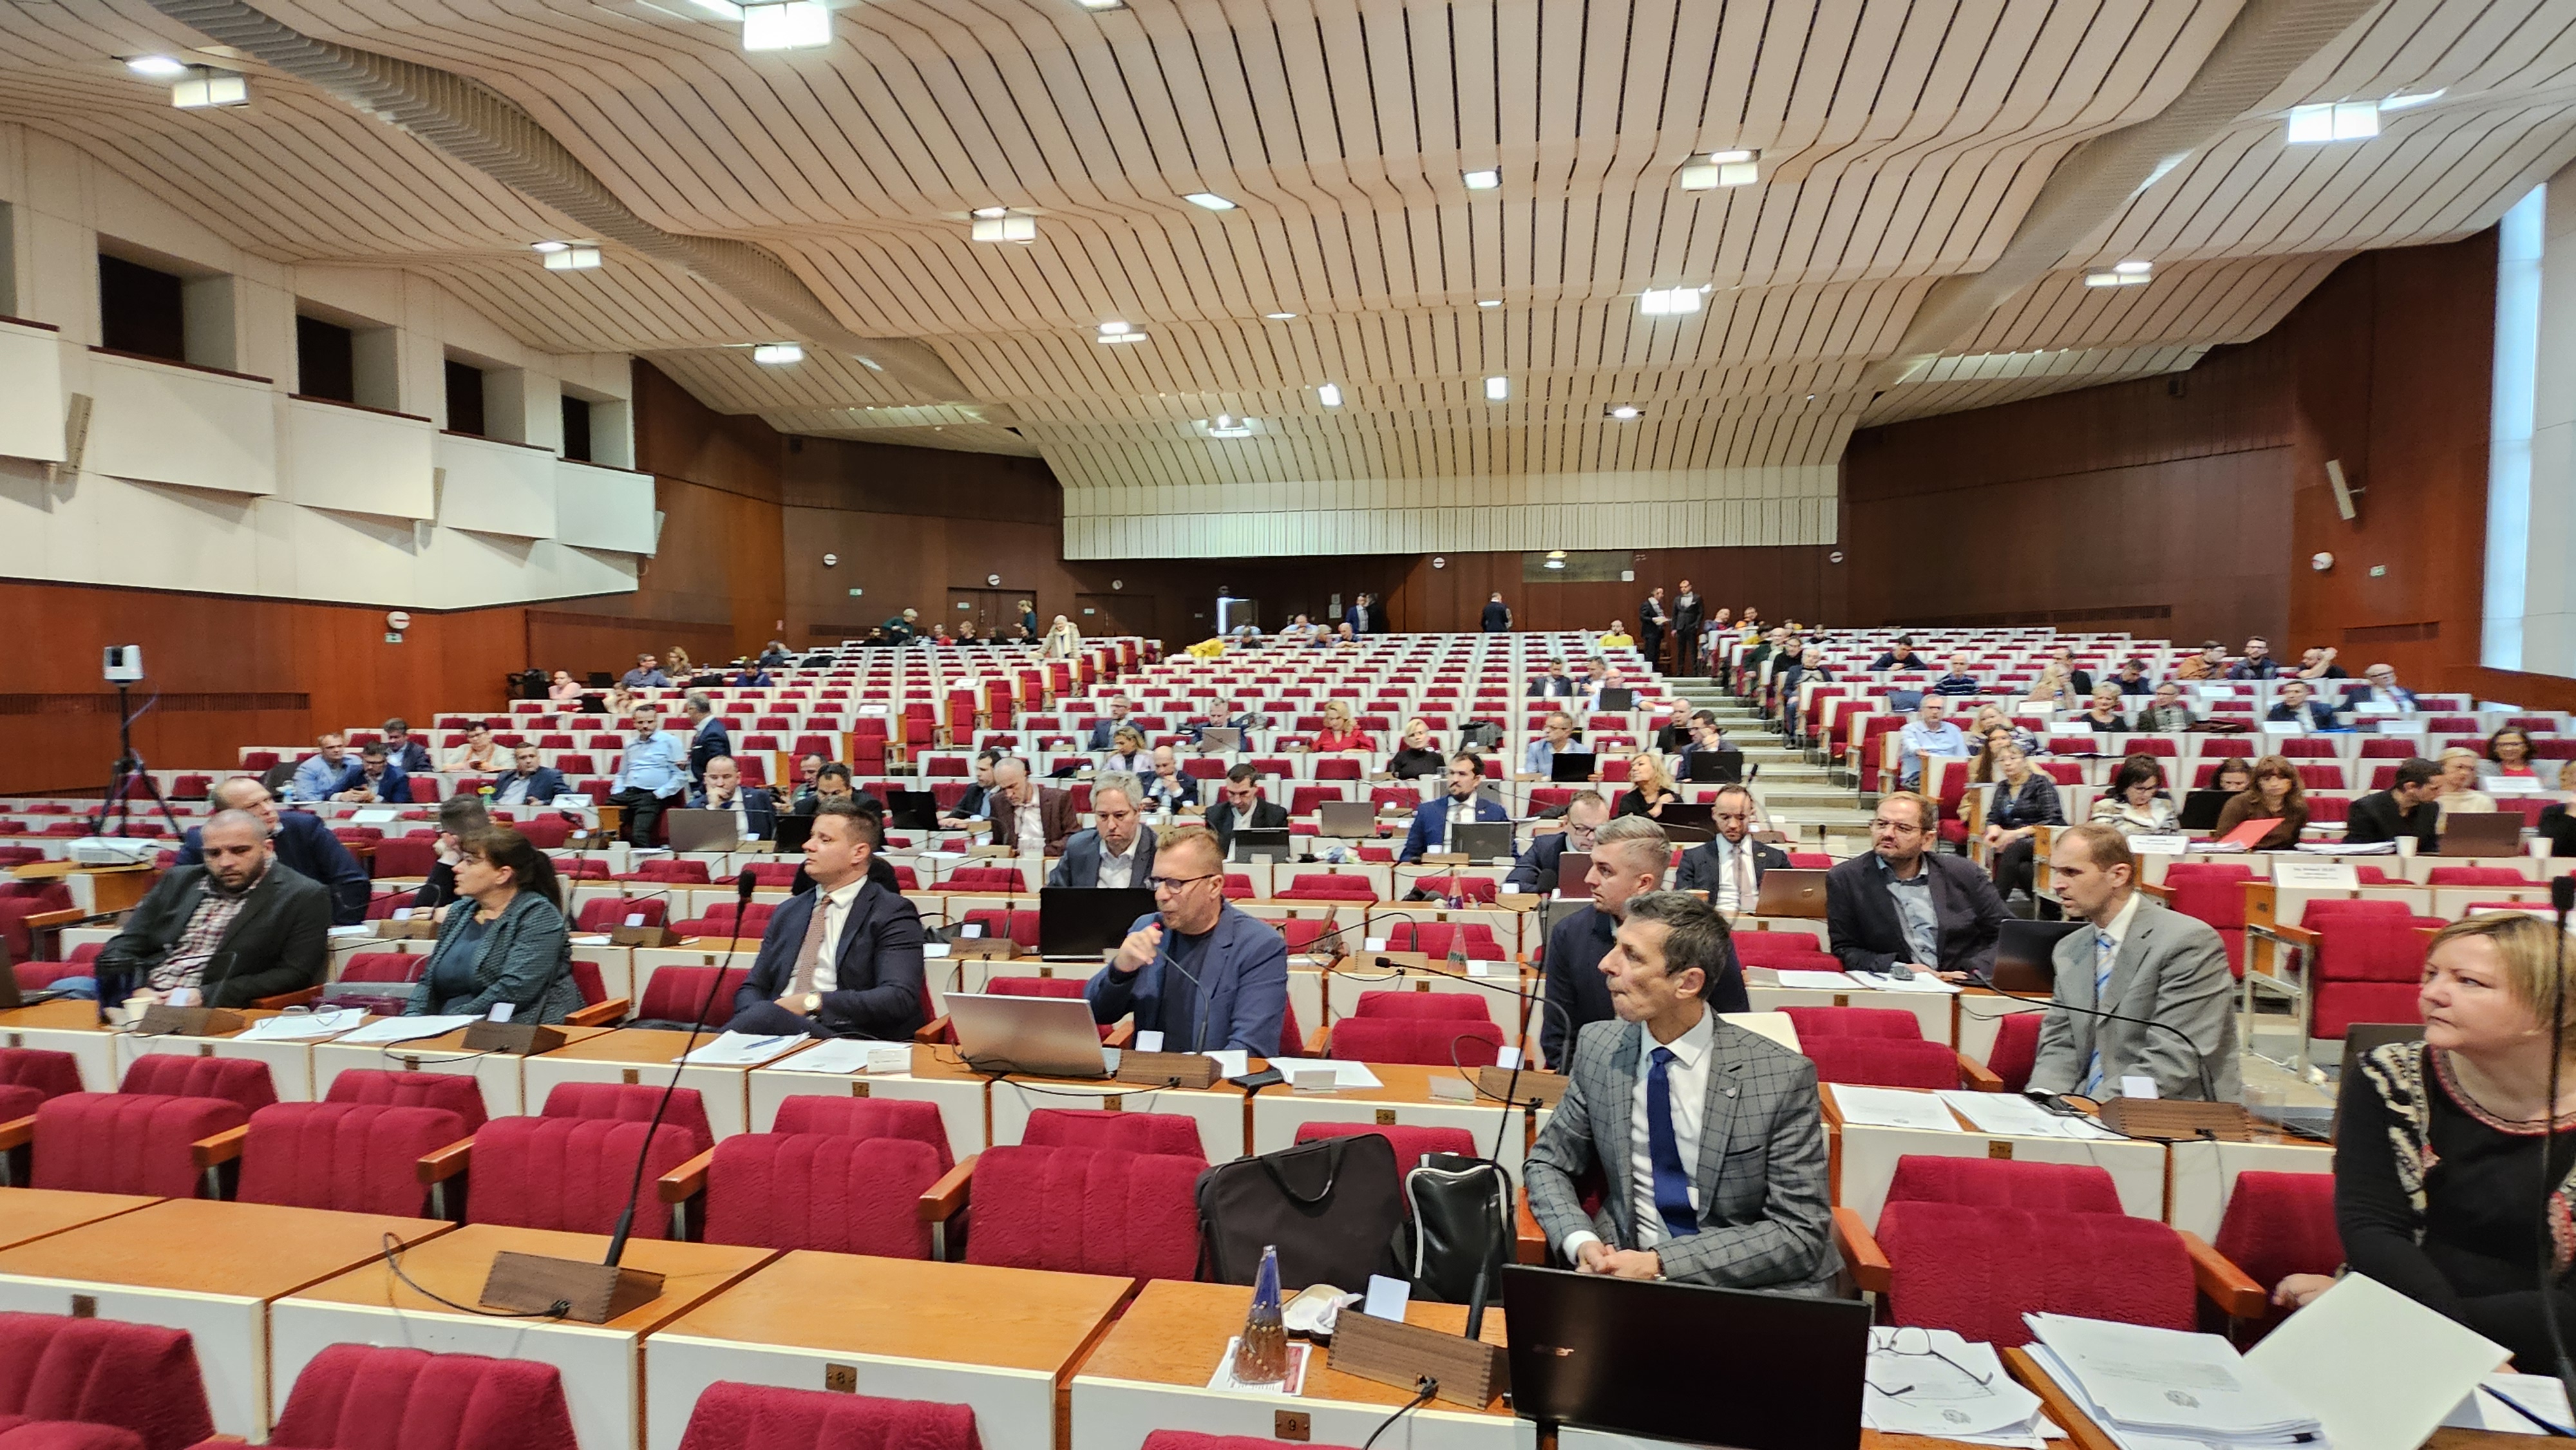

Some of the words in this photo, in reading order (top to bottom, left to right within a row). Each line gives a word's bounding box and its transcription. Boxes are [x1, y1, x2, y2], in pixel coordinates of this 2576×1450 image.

[1531, 1344, 1575, 1357] er
[837, 1372, 845, 1384] 8
[1289, 1418, 1296, 1431] 9
